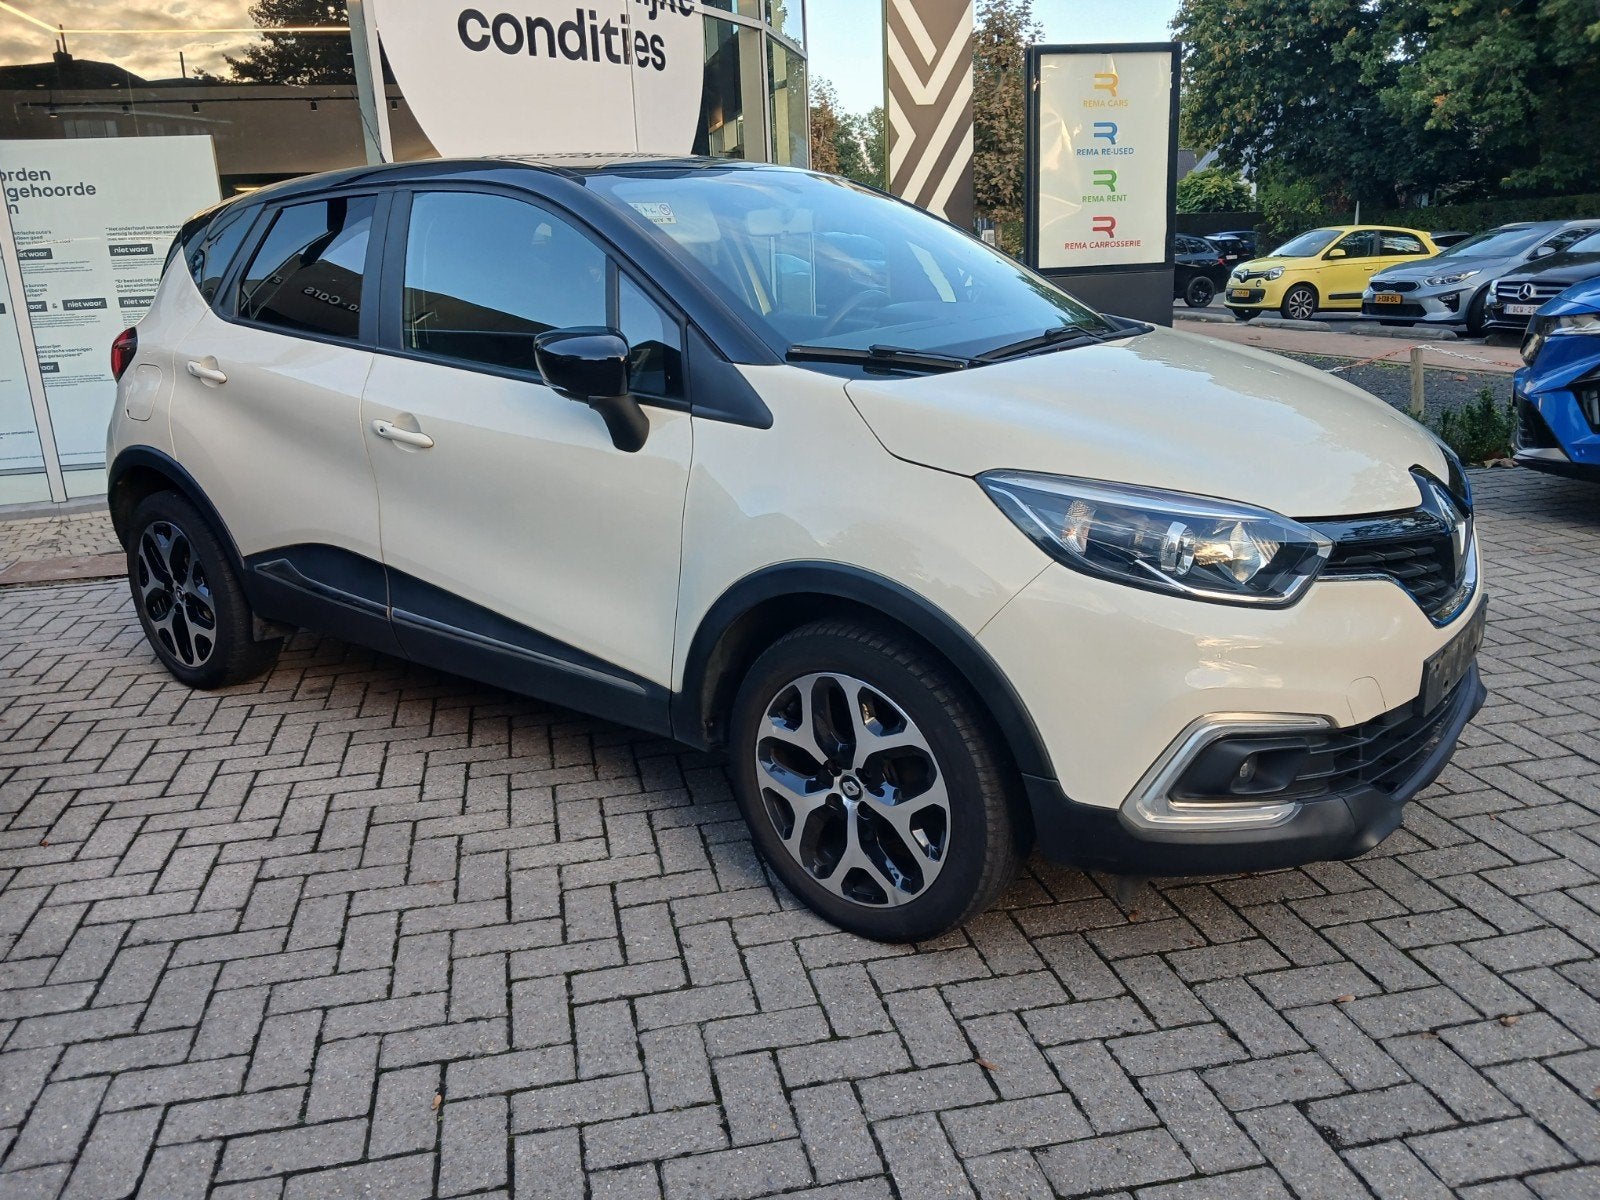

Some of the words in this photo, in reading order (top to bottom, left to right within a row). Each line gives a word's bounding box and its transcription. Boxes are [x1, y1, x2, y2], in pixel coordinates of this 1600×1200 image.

[457, 8, 666, 72] condities
[1083, 100, 1105, 108] REMA
[1107, 99, 1129, 107] CARS
[1076, 148, 1099, 156] REMA
[1101, 147, 1135, 156] RE-USED
[6, 182, 97, 201] gehoorde
[1082, 195, 1105, 203] REMA
[1106, 194, 1128, 202] RENT
[1065, 241, 1088, 250] REMA
[1089, 239, 1142, 249] CARROSSERIE
